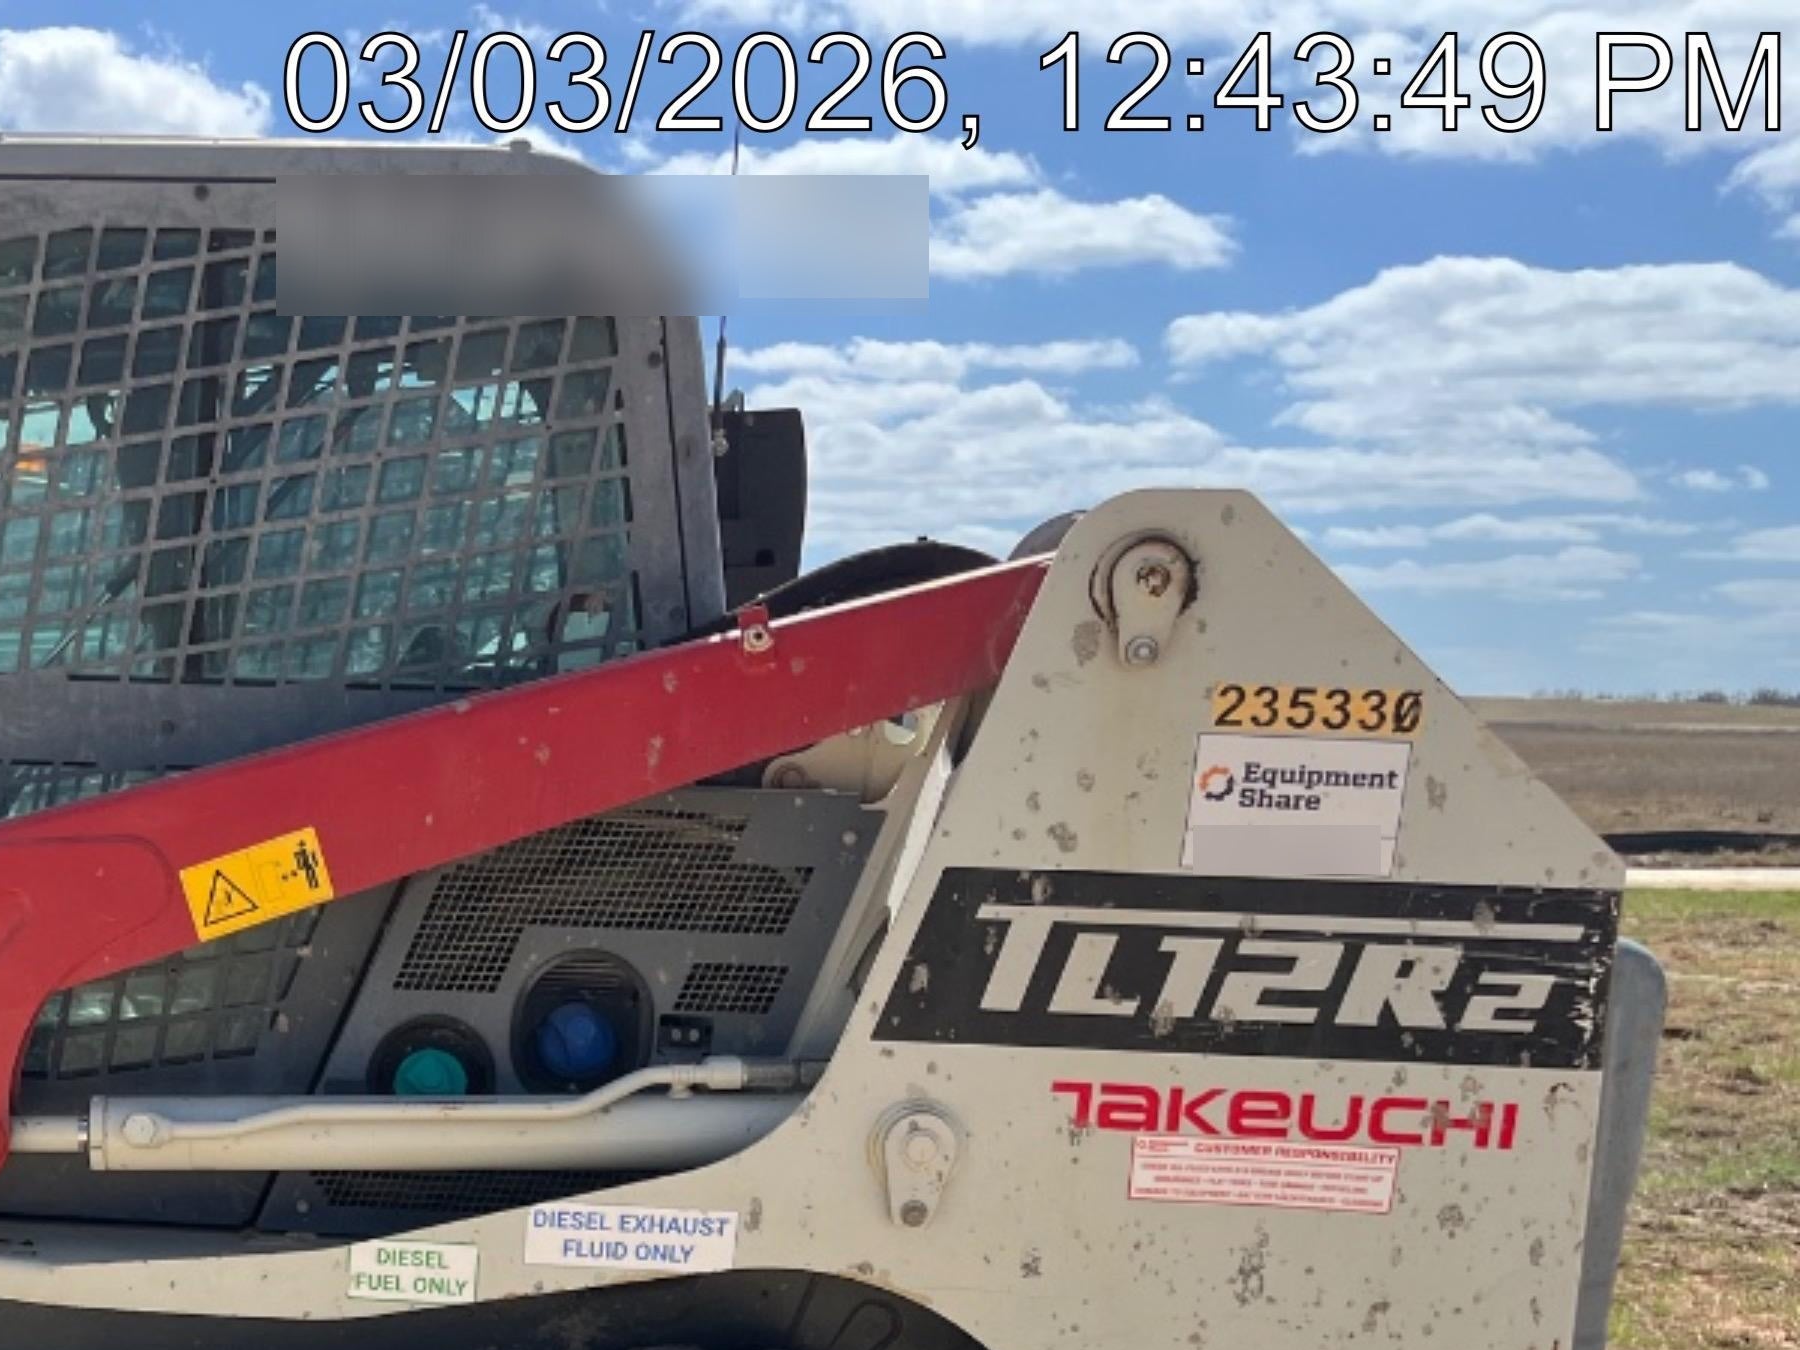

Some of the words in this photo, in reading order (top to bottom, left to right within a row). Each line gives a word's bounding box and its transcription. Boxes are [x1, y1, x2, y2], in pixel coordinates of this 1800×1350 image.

[1214, 683, 1424, 733] 235330
[1241, 761, 1399, 789] Equipment
[1237, 788, 1322, 811] Share
[533, 1209, 611, 1231] DIESEL
[618, 1213, 730, 1237] EXHAUST
[377, 1248, 450, 1269] DIESEL
[563, 1238, 628, 1261] FLUID
[635, 1242, 695, 1264] ONLY
[356, 1272, 406, 1292] FUEL
[413, 1277, 469, 1297] ONLY
